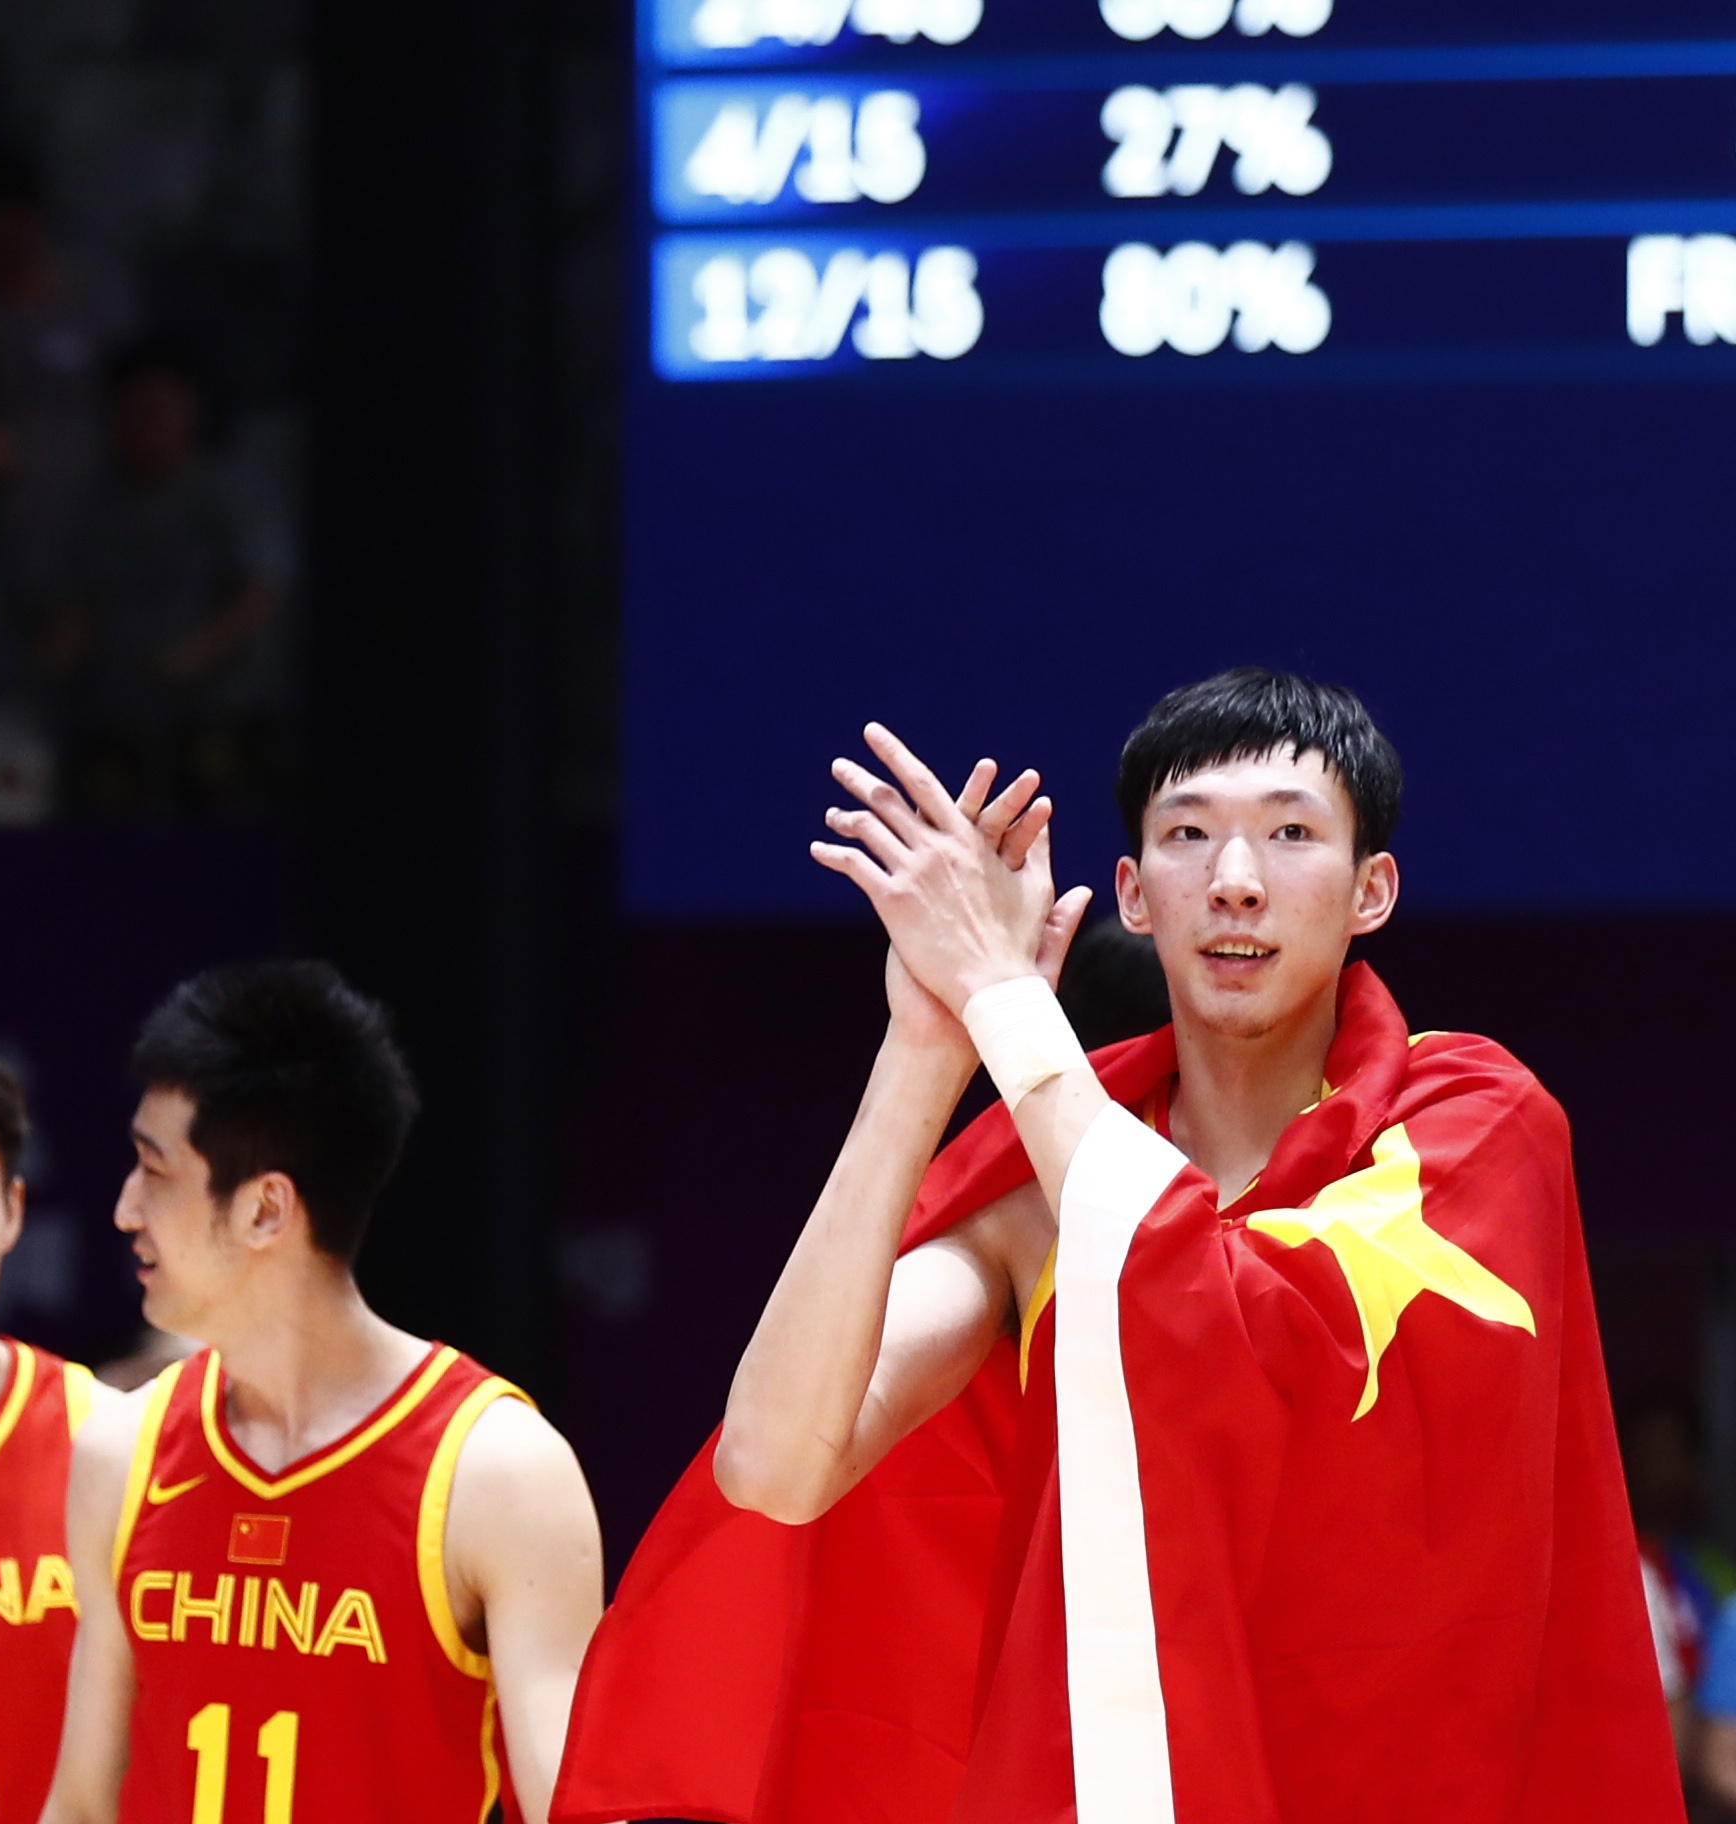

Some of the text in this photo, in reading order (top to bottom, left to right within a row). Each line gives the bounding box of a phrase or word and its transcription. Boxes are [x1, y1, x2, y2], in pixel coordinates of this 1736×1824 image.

[686, 92, 924, 203] 4/15
[1101, 84, 1332, 197] 27%
[691, 246, 982, 360] 12/15
[1100, 241, 1332, 357] 80%
[131, 1570, 387, 1664] CHINA
